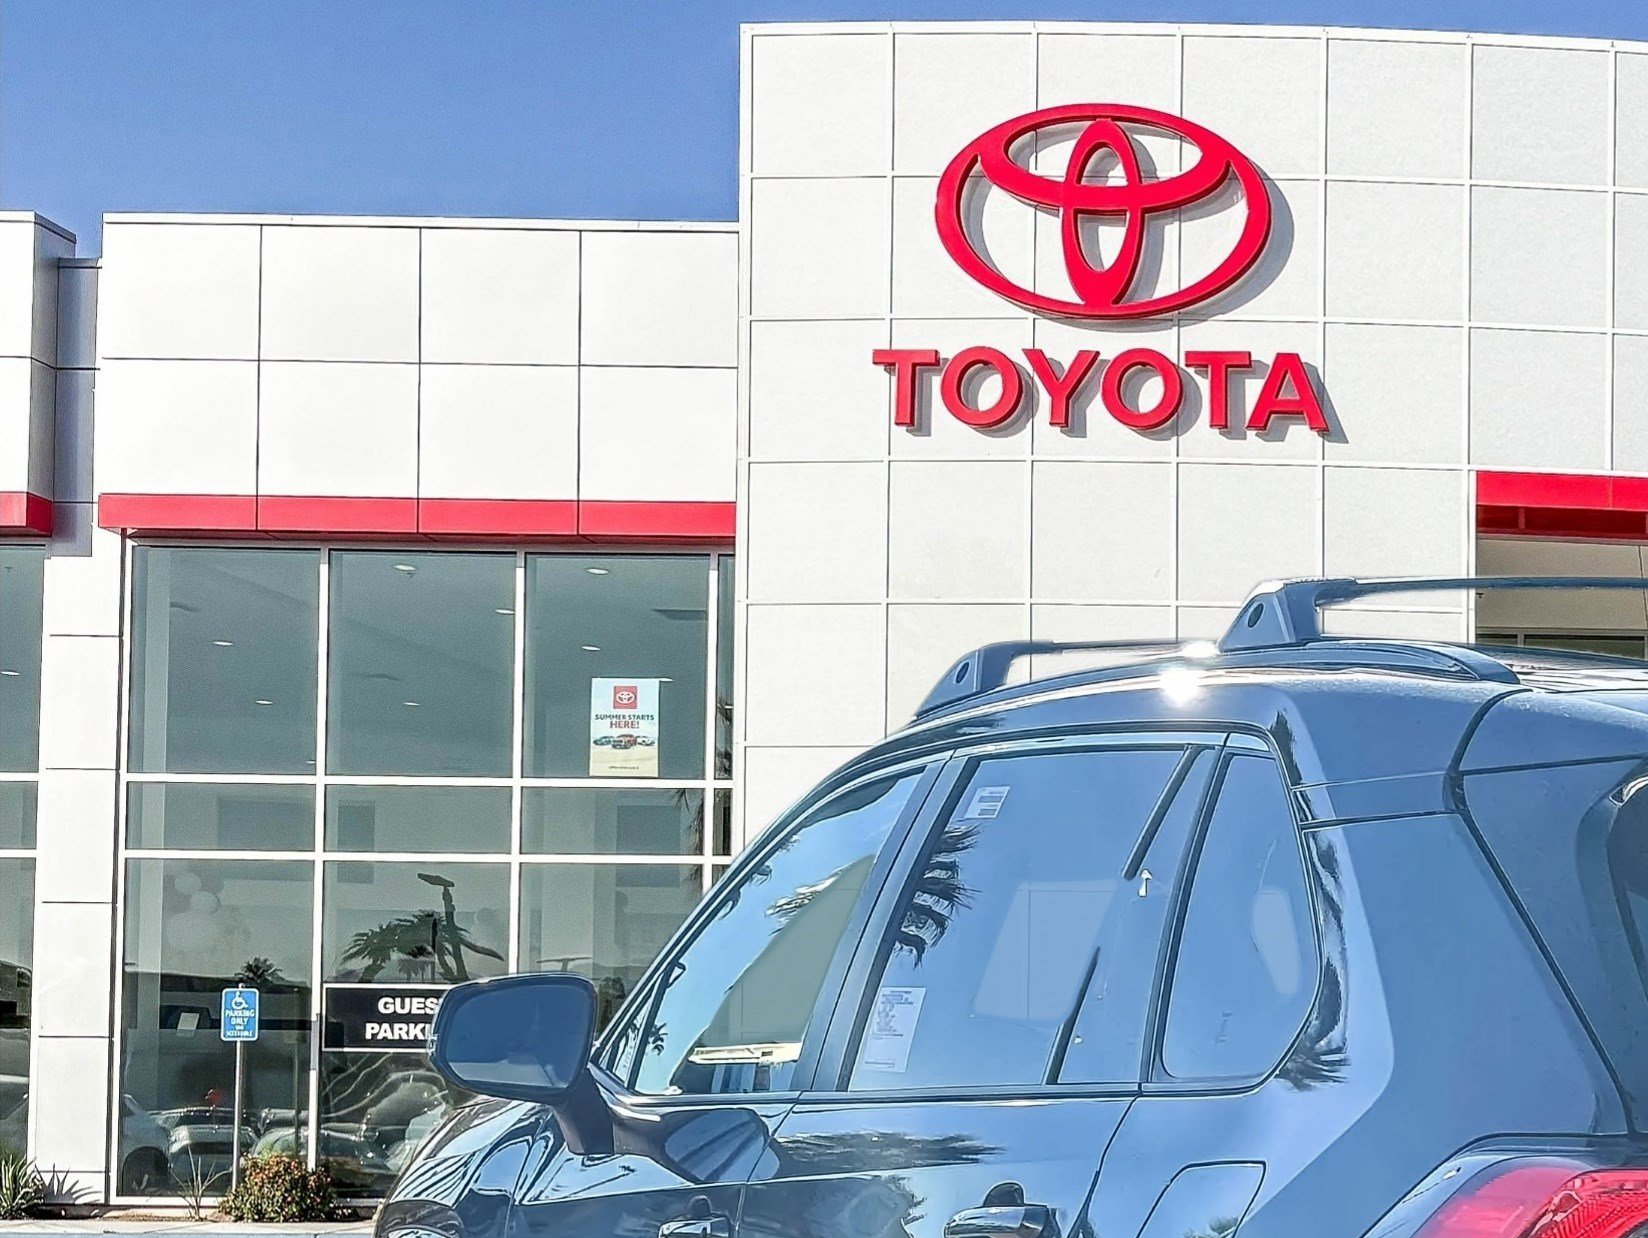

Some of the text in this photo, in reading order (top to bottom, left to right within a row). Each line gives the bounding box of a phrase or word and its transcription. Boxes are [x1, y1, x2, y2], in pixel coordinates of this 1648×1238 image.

[872, 346, 1329, 431] TOYOTA
[610, 720, 640, 729] HERE!
[377, 997, 443, 1015] GUES
[225, 1009, 255, 1018] PARKING
[230, 1017, 249, 1025] ONLY
